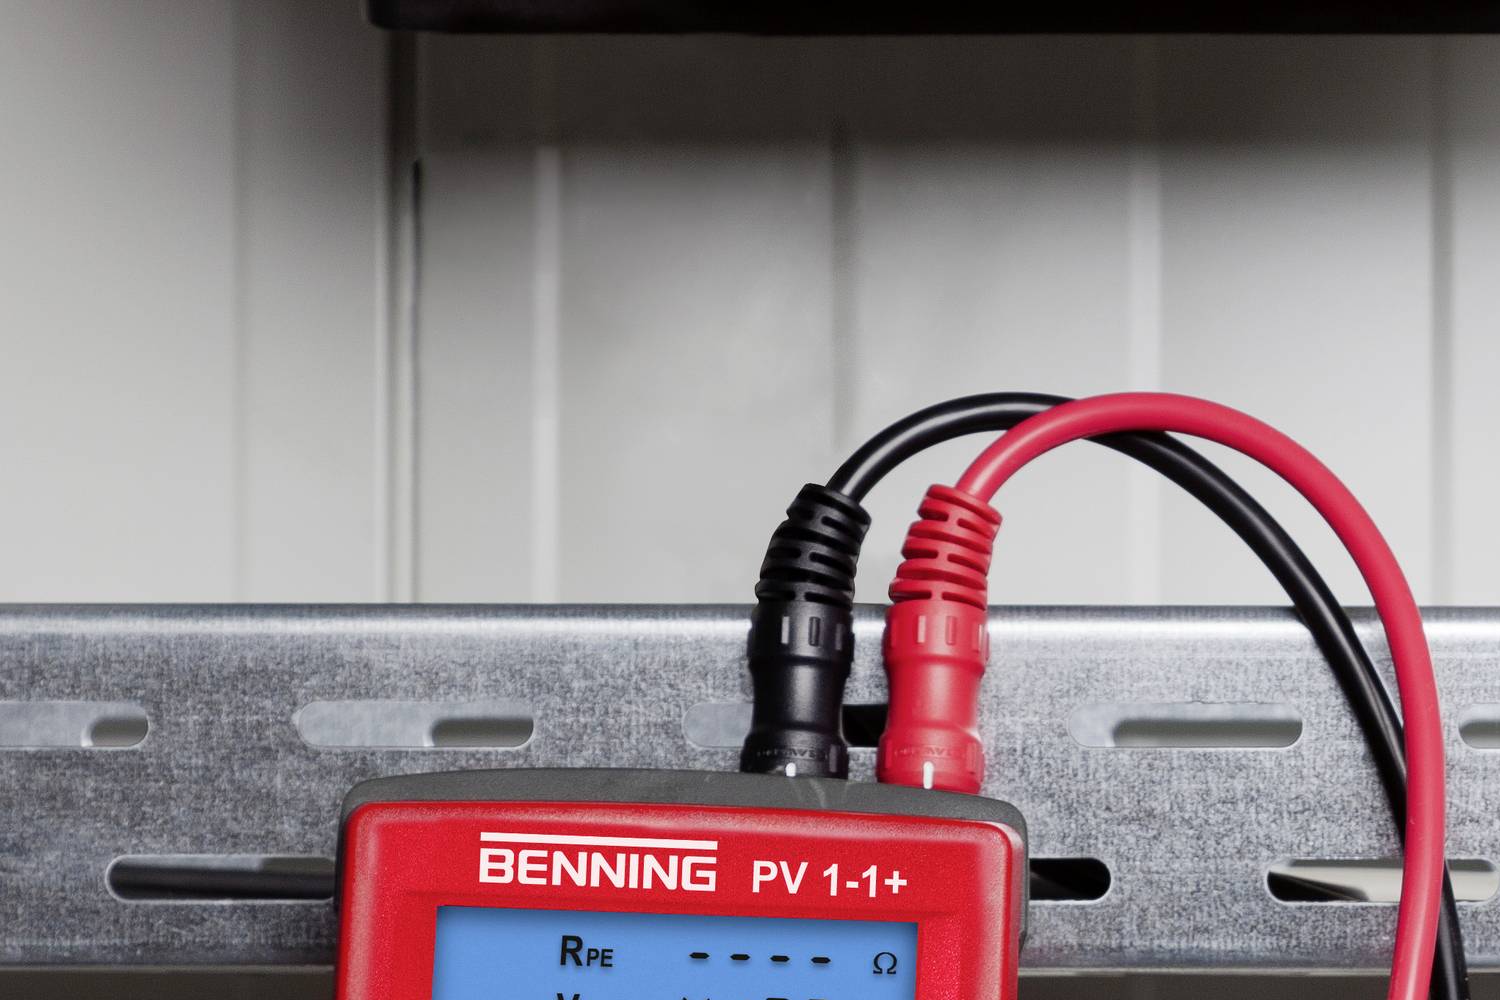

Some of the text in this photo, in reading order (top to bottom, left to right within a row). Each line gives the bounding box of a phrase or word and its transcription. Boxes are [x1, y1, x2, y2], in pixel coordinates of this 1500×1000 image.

[479, 848, 717, 891] BENNING
[753, 861, 907, 897] PV 1-1+
[560, 935, 613, 967] RPE
